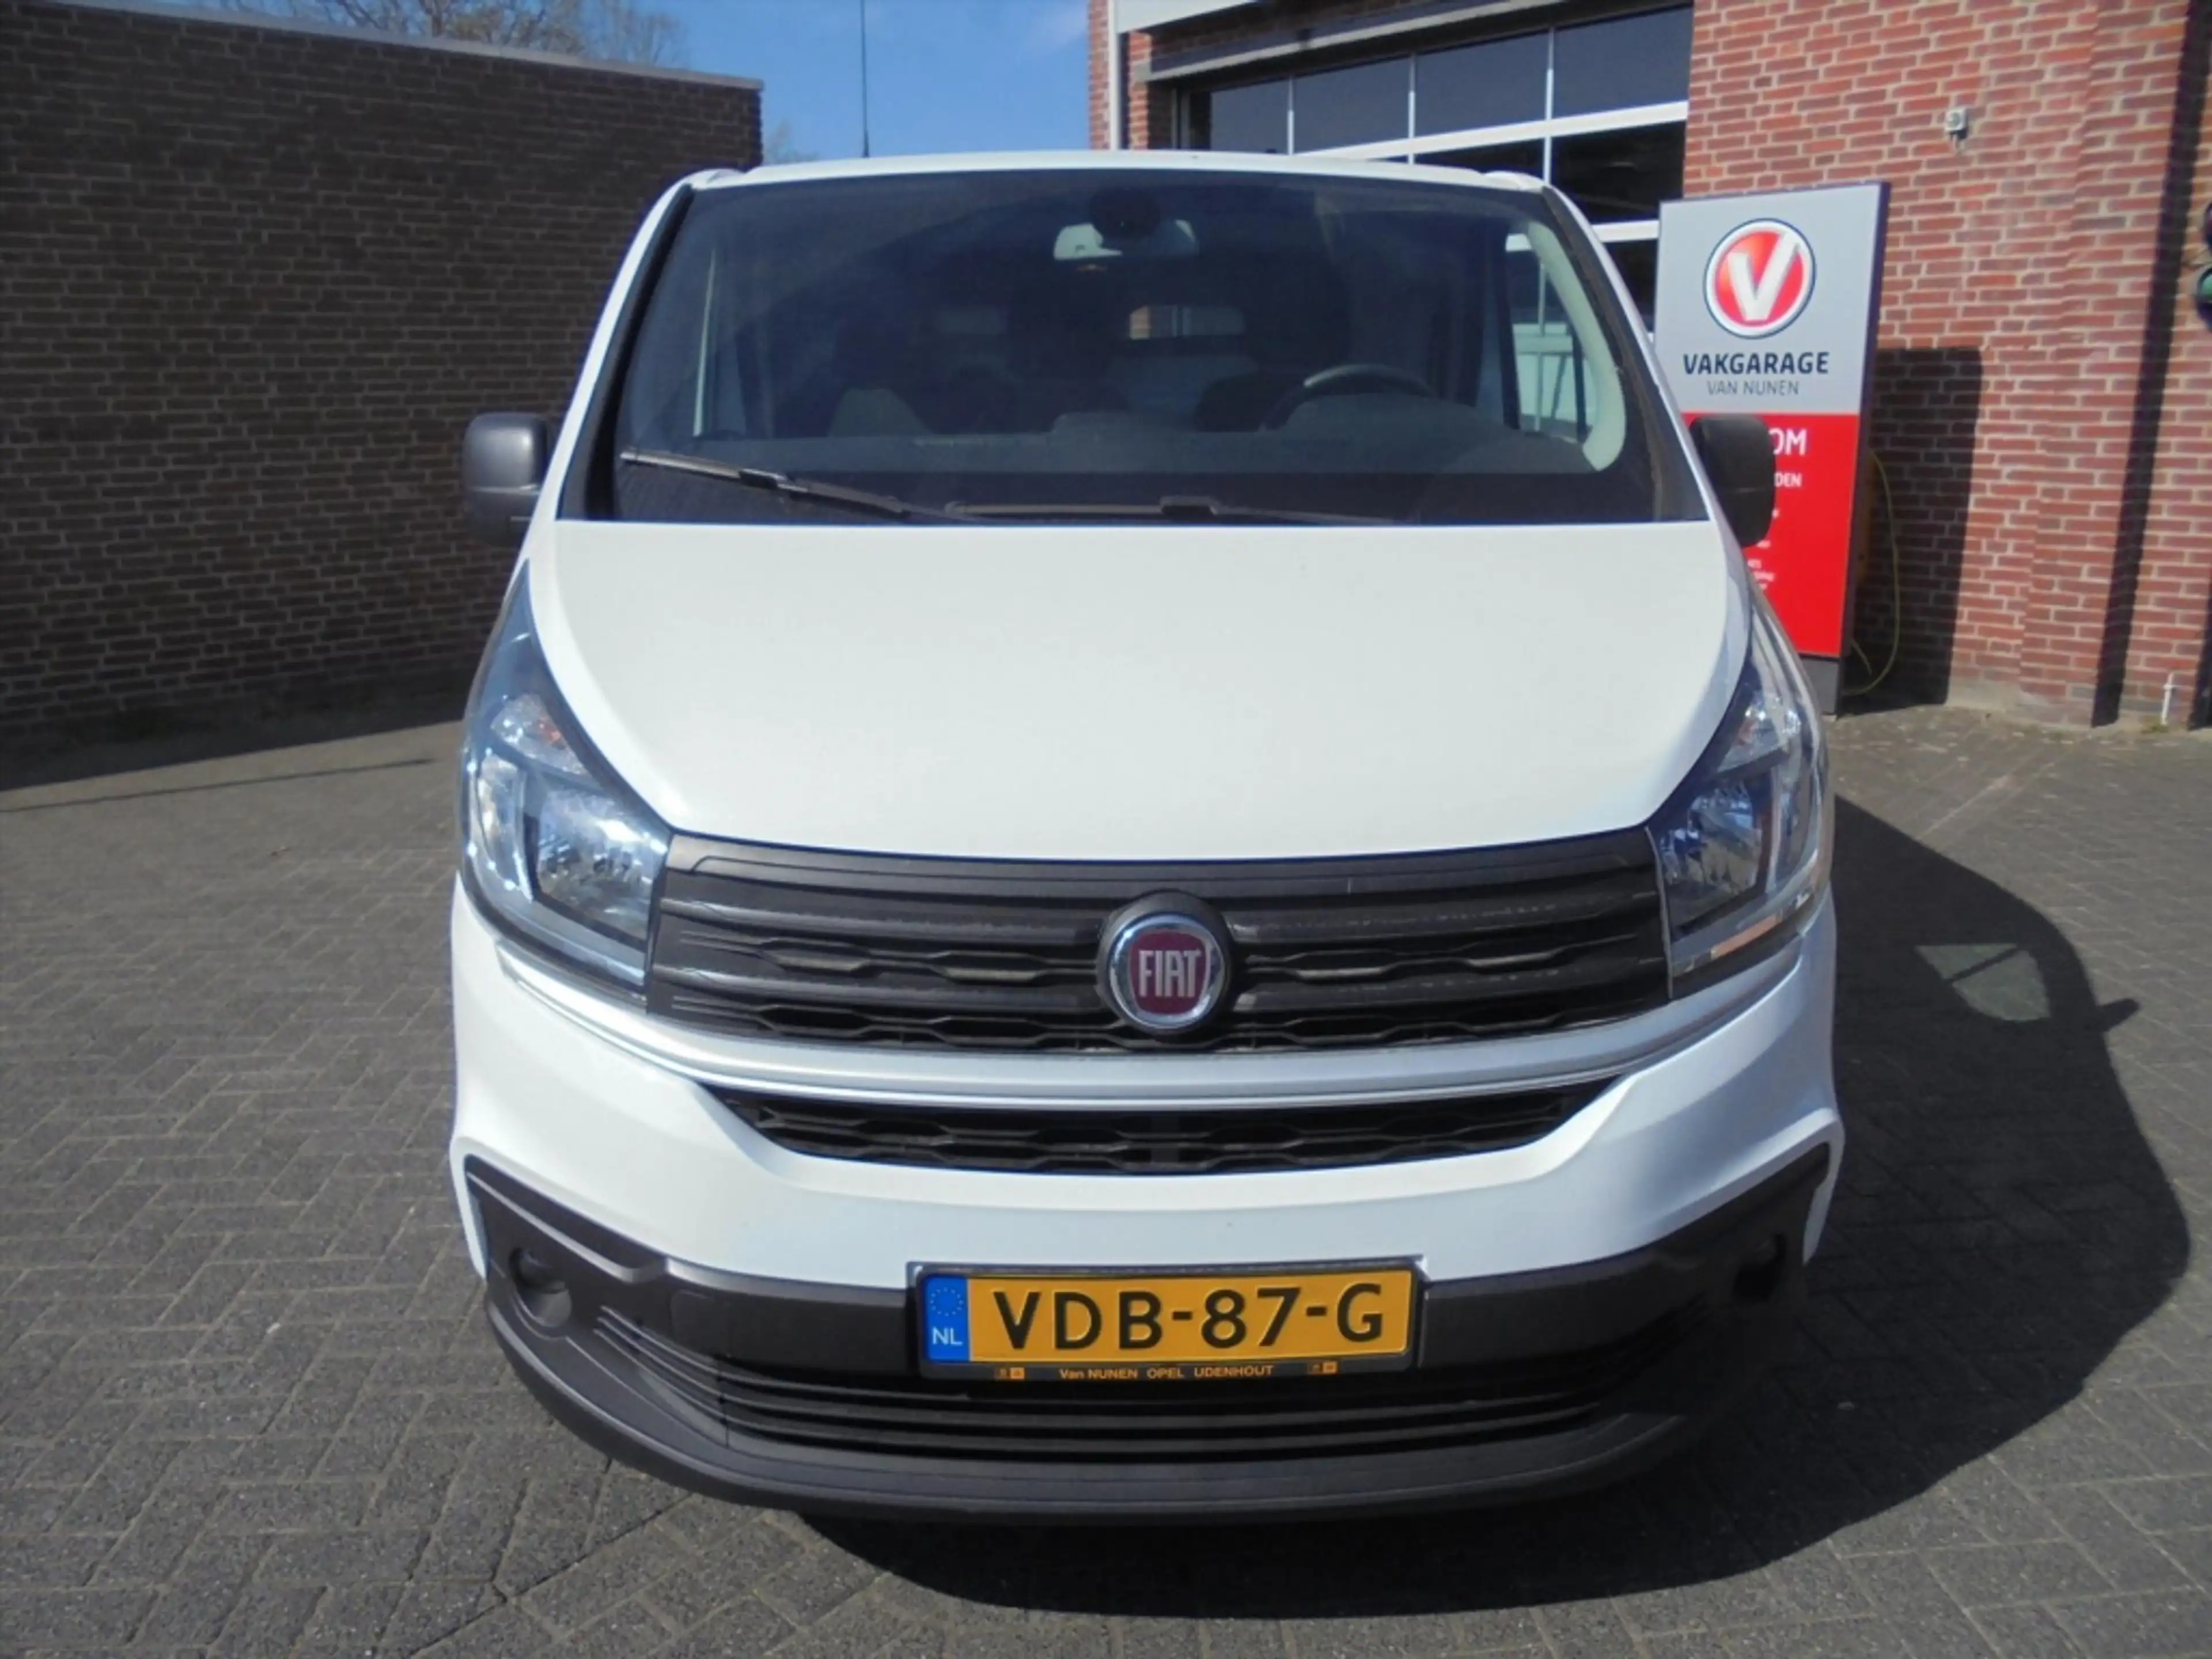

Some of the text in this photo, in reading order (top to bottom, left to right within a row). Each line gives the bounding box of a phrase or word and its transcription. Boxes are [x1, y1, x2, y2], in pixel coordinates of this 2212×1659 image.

[1728, 231, 1797, 321] V
[1683, 351, 1830, 376] VAKGARAGE
[1707, 379, 1799, 396] VAN NUNEN
[1768, 427, 1808, 456] OM
[1774, 472, 1802, 488] DEN
[1138, 948, 1202, 998] FIAT
[931, 1282, 1384, 1351] NL VDB-87-G
[1058, 1368, 1085, 1380] Van
[1088, 1368, 1139, 1380] NUNEN
[1146, 1366, 1185, 1379] OPEL
